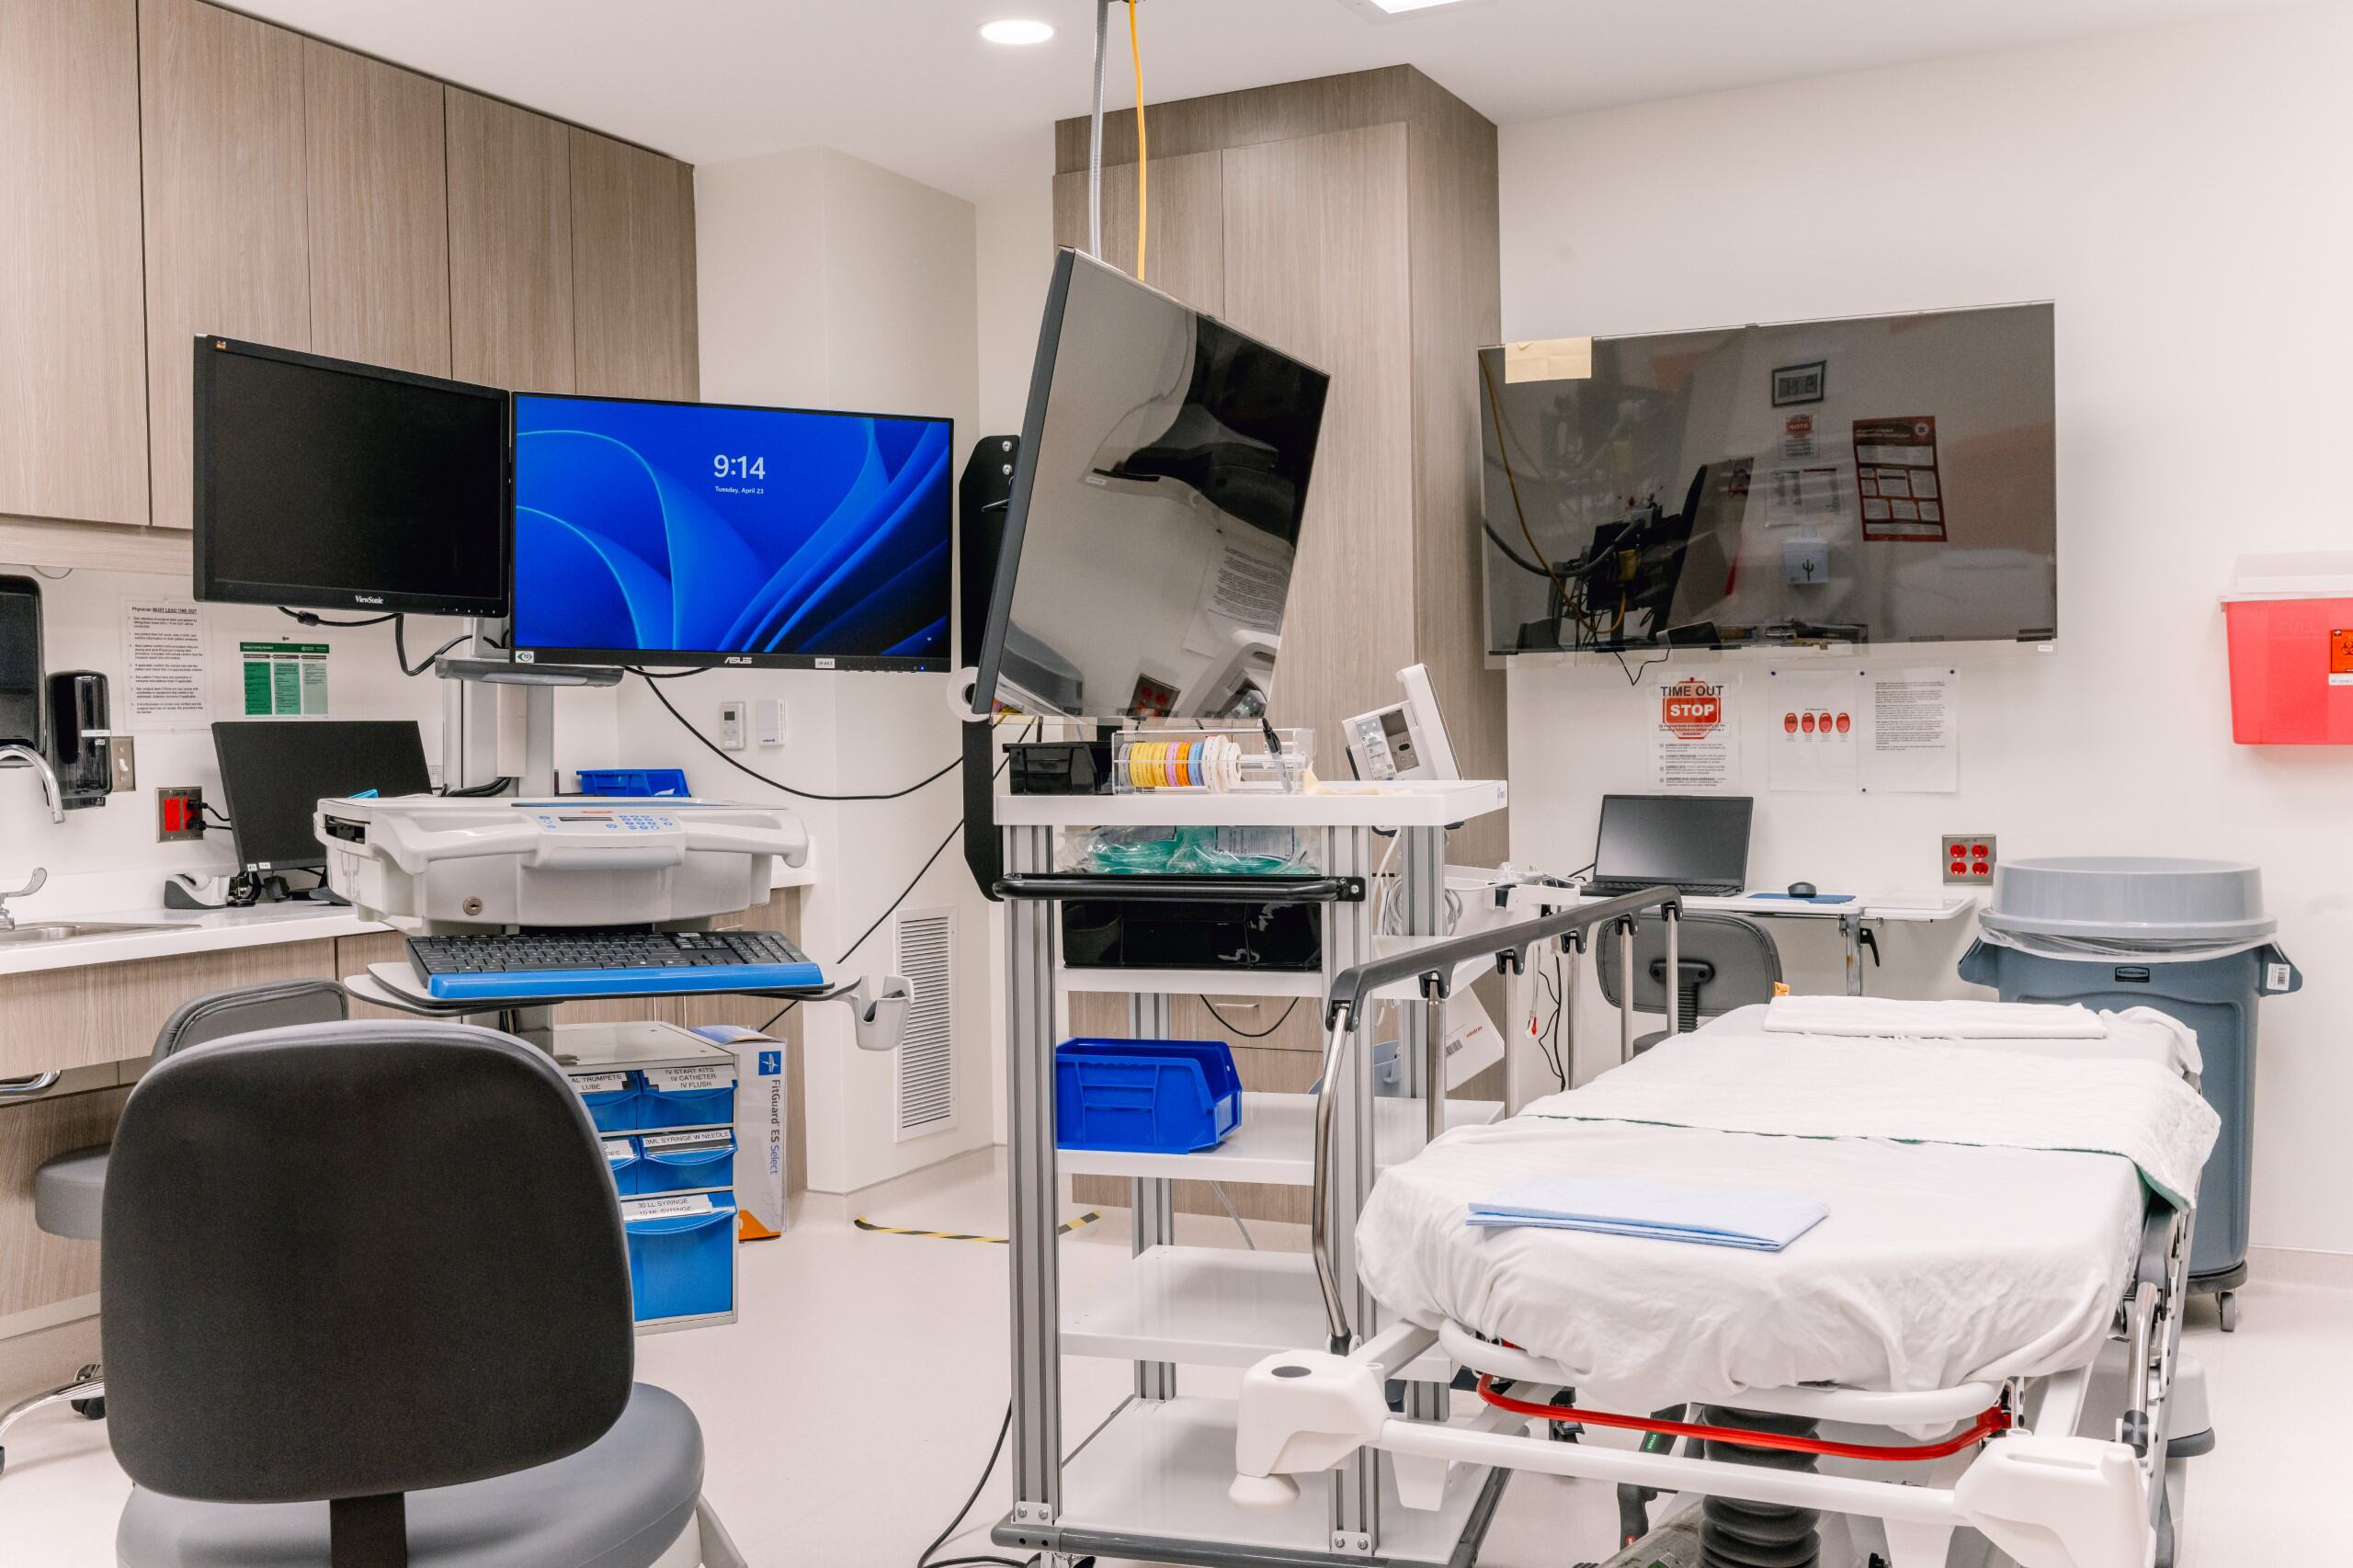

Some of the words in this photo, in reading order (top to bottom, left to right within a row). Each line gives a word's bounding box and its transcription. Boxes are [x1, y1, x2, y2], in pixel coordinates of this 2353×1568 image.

[714, 455, 765, 479] 9:14
[715, 486, 740, 494] Tuesday,
[355, 596, 383, 604] ViewSonic
[1660, 686, 1691, 697] TIME
[1696, 686, 1723, 697] OUT
[1670, 704, 1714, 717] STOP
[583, 1074, 622, 1083] TRUMPETS
[701, 1131, 730, 1140] NEEDLE
[770, 1130, 779, 1142] ES
[770, 1144, 779, 1175] Select
[657, 1199, 688, 1207] SYRINGE
